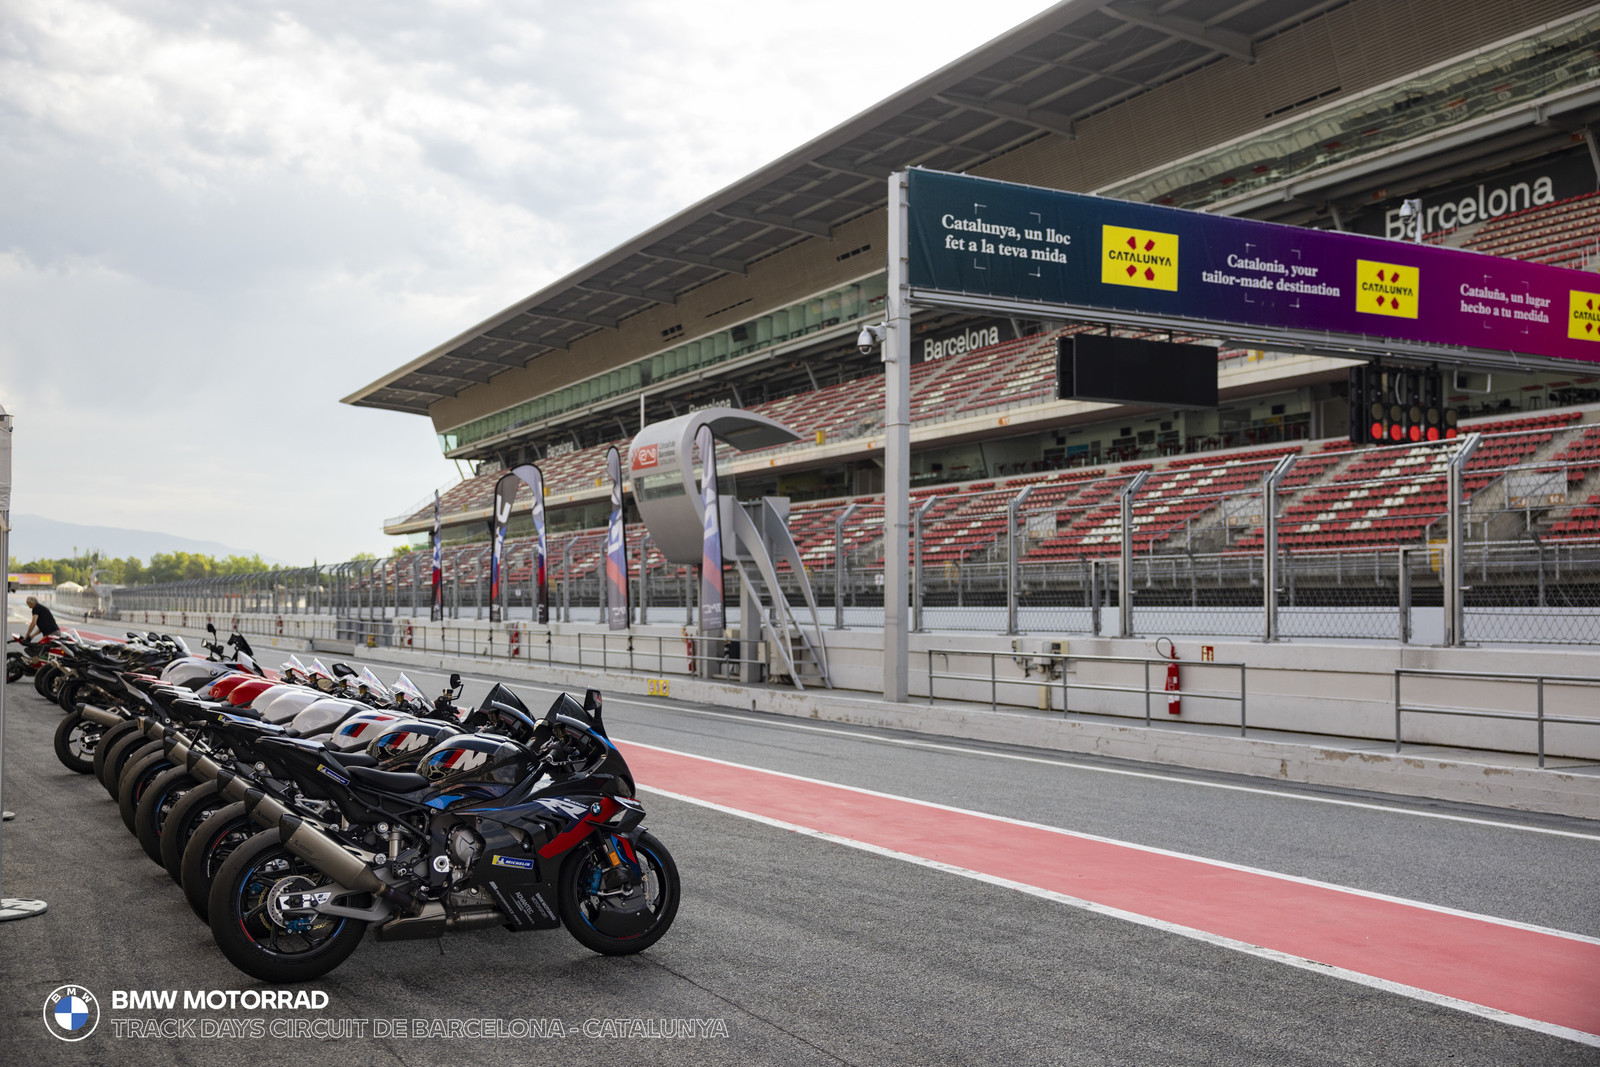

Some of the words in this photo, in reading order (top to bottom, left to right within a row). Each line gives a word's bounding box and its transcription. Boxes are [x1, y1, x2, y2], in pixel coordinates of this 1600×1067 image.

[1385, 176, 1555, 240] Barcelona
[941, 213, 1021, 240] Catalunya,
[1024, 228, 1043, 241] un
[1046, 228, 1071, 245] lloc
[945, 234, 965, 250] fet
[968, 240, 978, 252] a
[981, 238, 995, 254] la
[998, 243, 1028, 258] teva
[1031, 247, 1067, 263] mida
[1108, 250, 1172, 267] CATALUNYA
[1227, 254, 1289, 276] Catalonia,
[1290, 265, 1318, 277] your
[1201, 270, 1274, 290] tailor-made
[1276, 278, 1340, 297] destination
[1362, 282, 1414, 297] CATALUNYA
[1460, 283, 1509, 304] Cataluña,
[1511, 293, 1524, 303] un
[1525, 292, 1551, 308] lugar
[1460, 299, 1491, 315] hecho
[1493, 306, 1500, 316] a
[1501, 307, 1512, 318] tu
[1513, 309, 1550, 323] medida
[924, 326, 1000, 362] Barcelona
